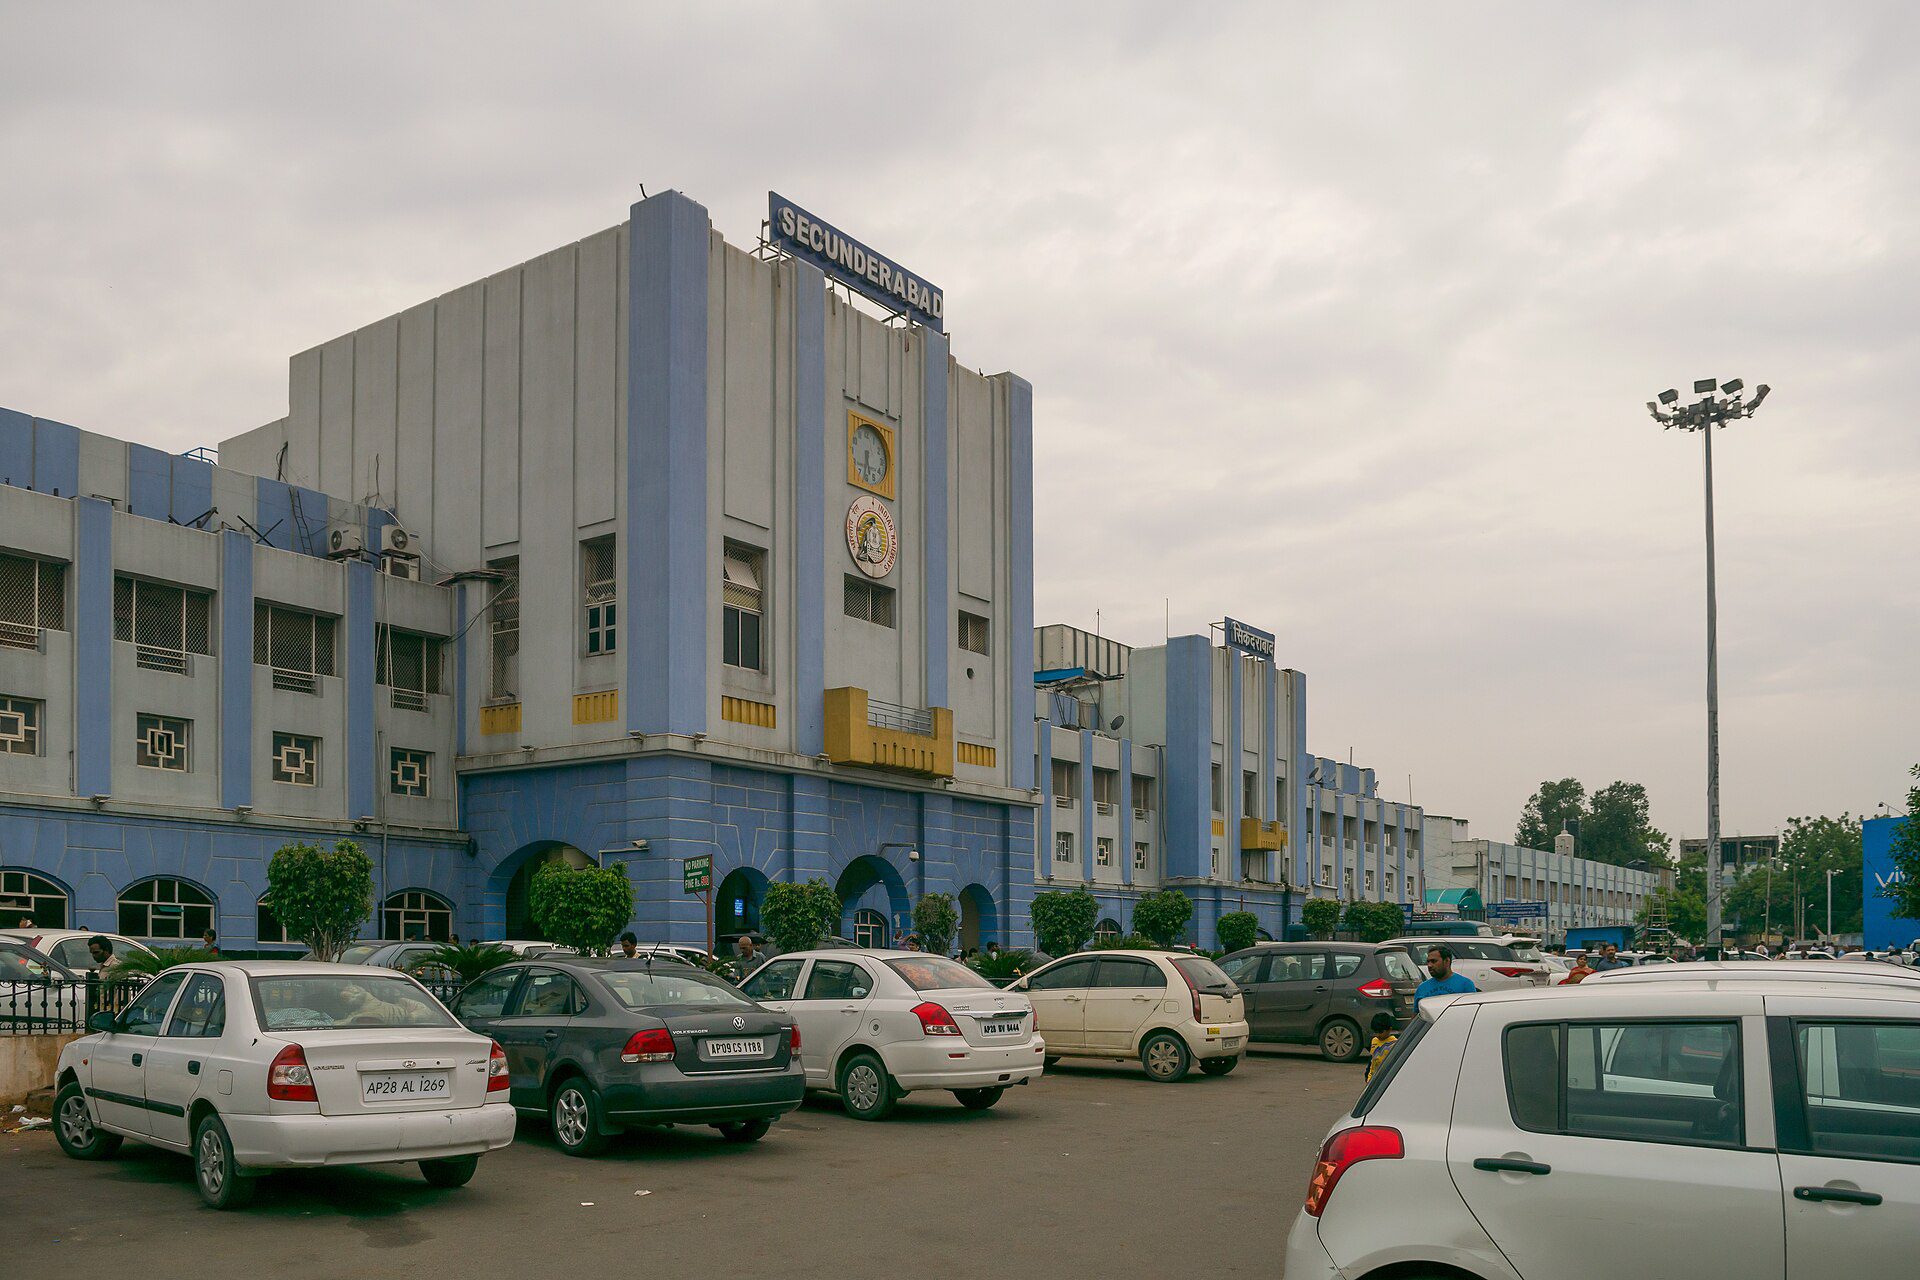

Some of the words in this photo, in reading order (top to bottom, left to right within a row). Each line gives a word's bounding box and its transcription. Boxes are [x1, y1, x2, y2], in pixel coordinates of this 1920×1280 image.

[779, 206, 943, 319] SECUNDERABAD
[878, 504, 894, 531] INDIAN
[883, 534, 897, 572] RAILWAYS
[685, 861, 692, 871] NO
[692, 858, 709, 870] PARKING
[685, 879, 694, 889] FINE
[711, 1042, 731, 1055] AP09
[732, 1042, 742, 1053] CS
[743, 1041, 762, 1053] 1188
[366, 1081, 397, 1094] AP28
[401, 1080, 415, 1093] AL
[419, 1079, 446, 1092] 1269
